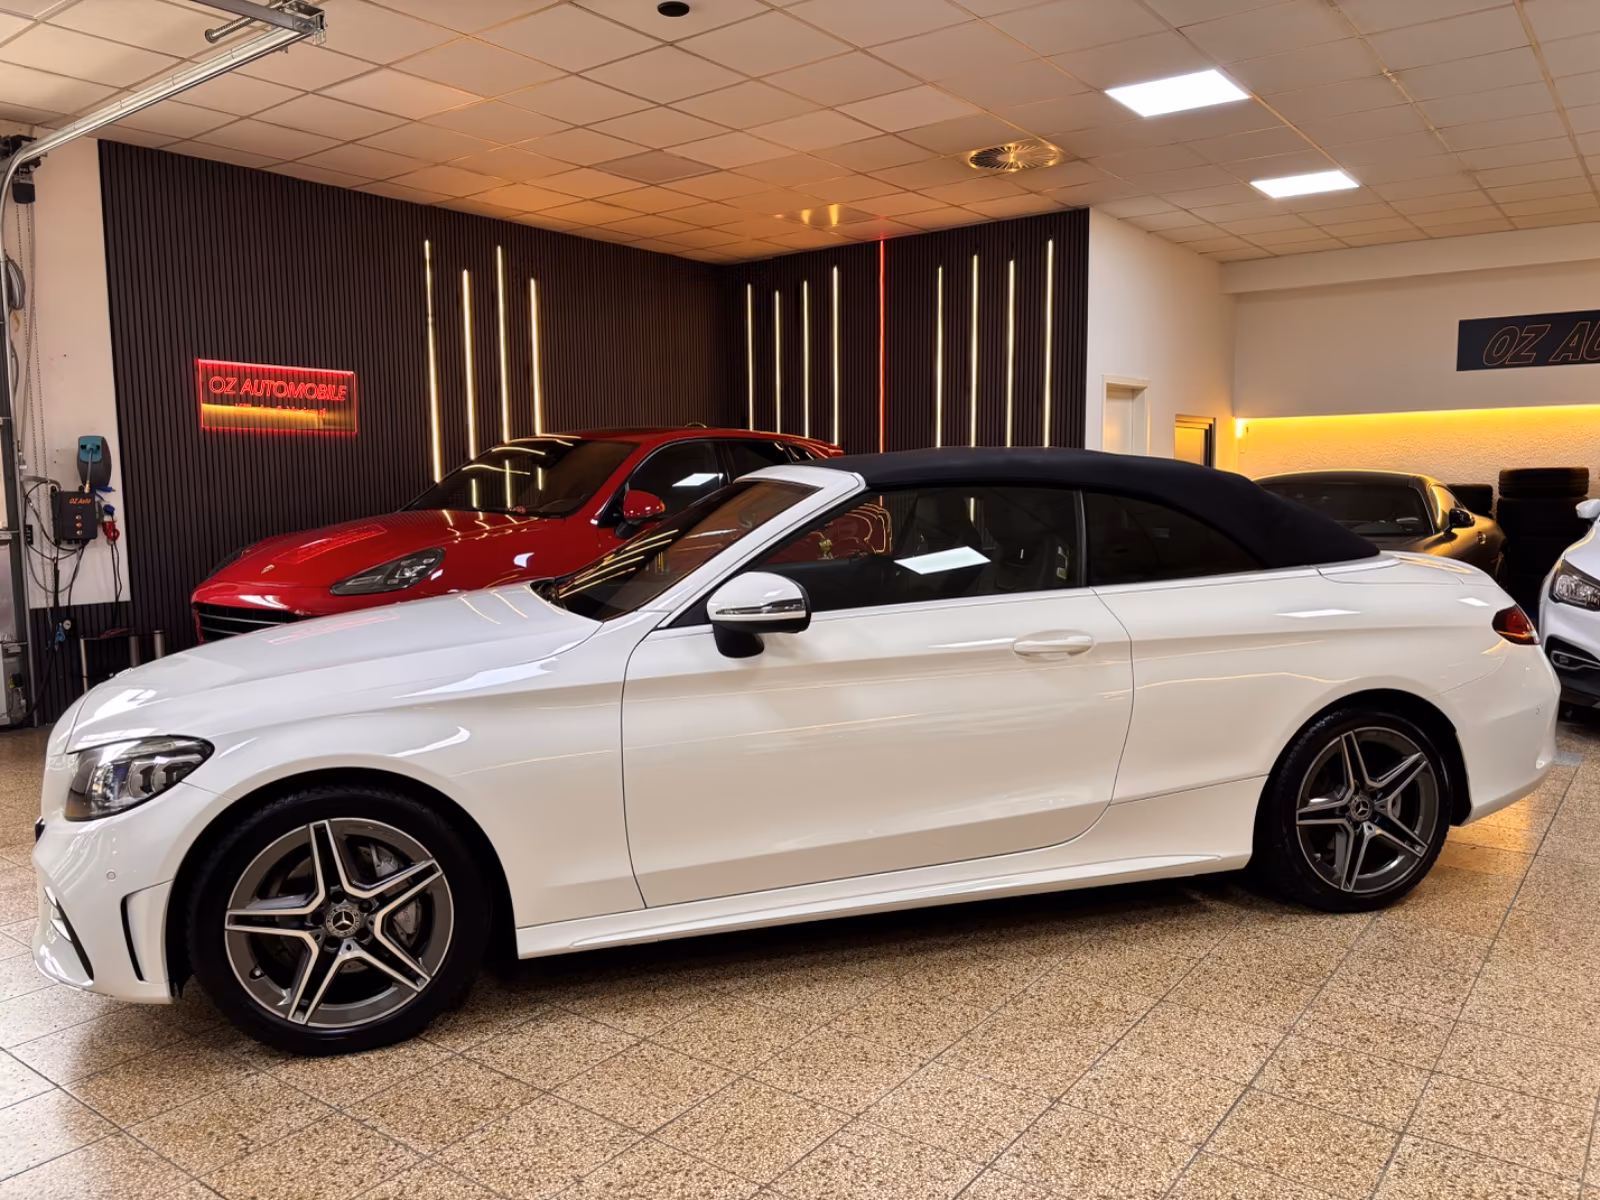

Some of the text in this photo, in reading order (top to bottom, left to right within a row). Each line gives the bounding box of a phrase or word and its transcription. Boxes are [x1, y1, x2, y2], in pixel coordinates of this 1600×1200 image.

[1482, 324, 1551, 366] OZ
[209, 376, 347, 401] OZ AUTOMOBILE
